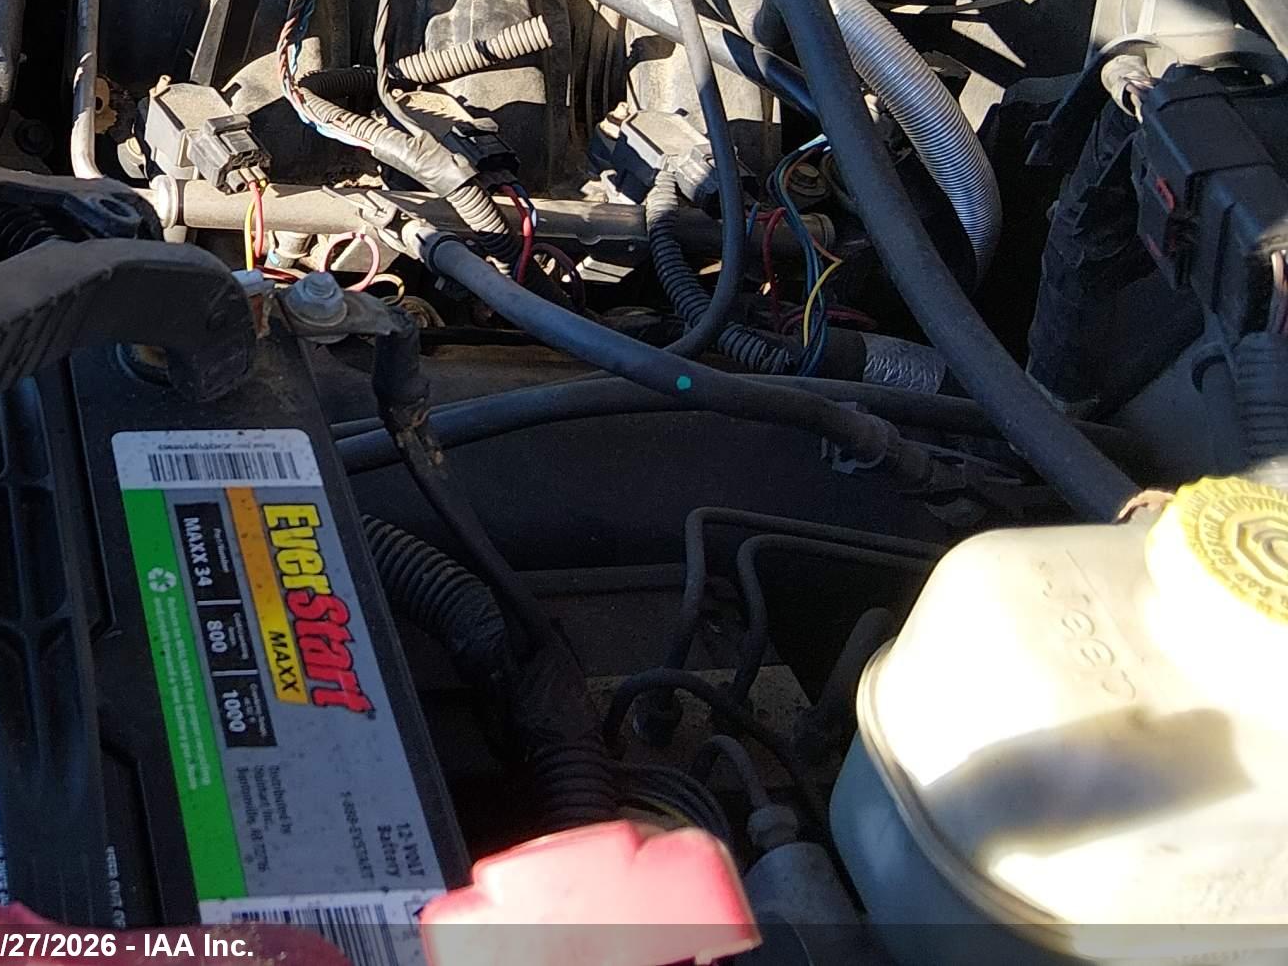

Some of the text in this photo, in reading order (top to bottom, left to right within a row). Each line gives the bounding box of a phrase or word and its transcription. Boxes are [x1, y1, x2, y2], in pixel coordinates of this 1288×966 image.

[183, 516, 214, 587] MAXX 34
[206, 620, 228, 654] 800
[262, 503, 374, 714] EverStart
[268, 630, 300, 694] MAXX
[222, 690, 246, 733] 1000
